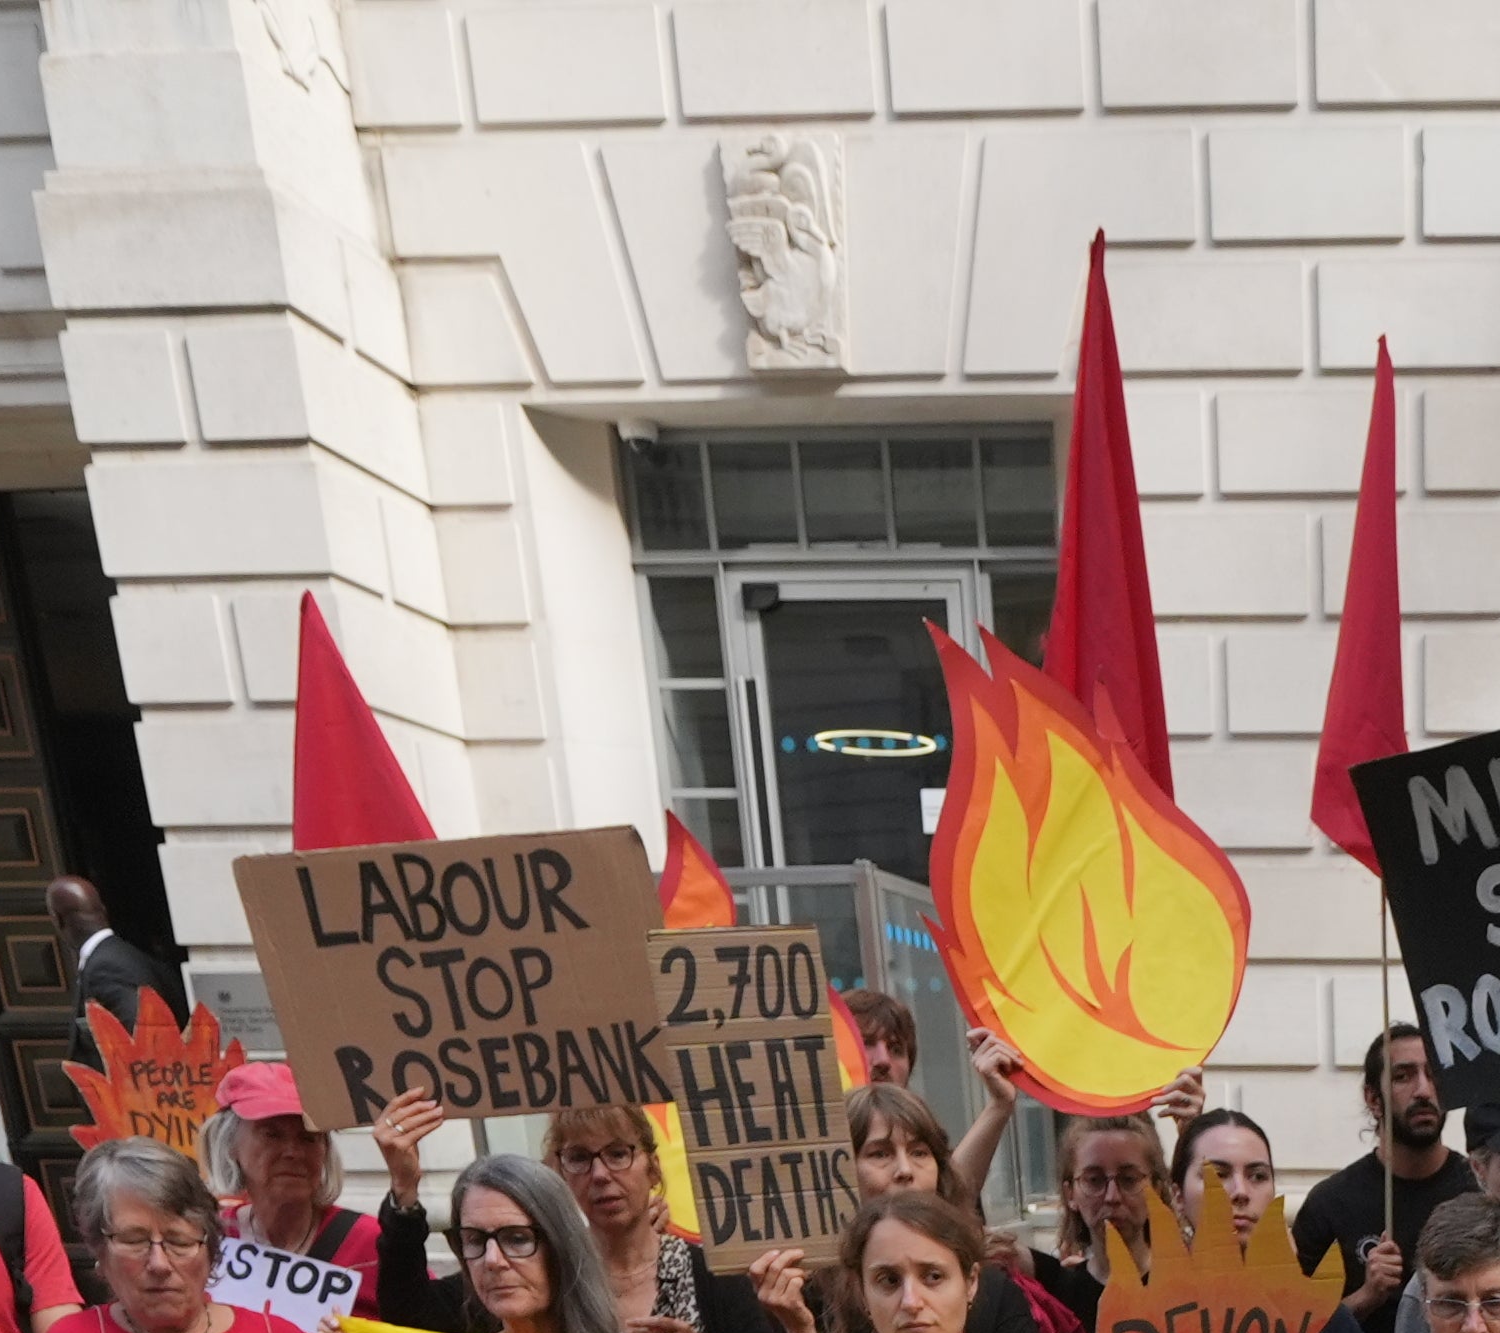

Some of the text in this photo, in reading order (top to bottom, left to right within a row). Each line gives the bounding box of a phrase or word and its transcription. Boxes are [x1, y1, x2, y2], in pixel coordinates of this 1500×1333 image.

[296, 848, 591, 948] LABOUR
[376, 945, 553, 1039] STOP
[660, 942, 818, 1029] 2,700
[129, 1059, 213, 1091] PEOPLE
[156, 1090, 195, 1111] ARE
[334, 1020, 675, 1124] ROSEBANK
[676, 1035, 829, 1147] HEAT
[696, 1148, 860, 1247] DEATHS
